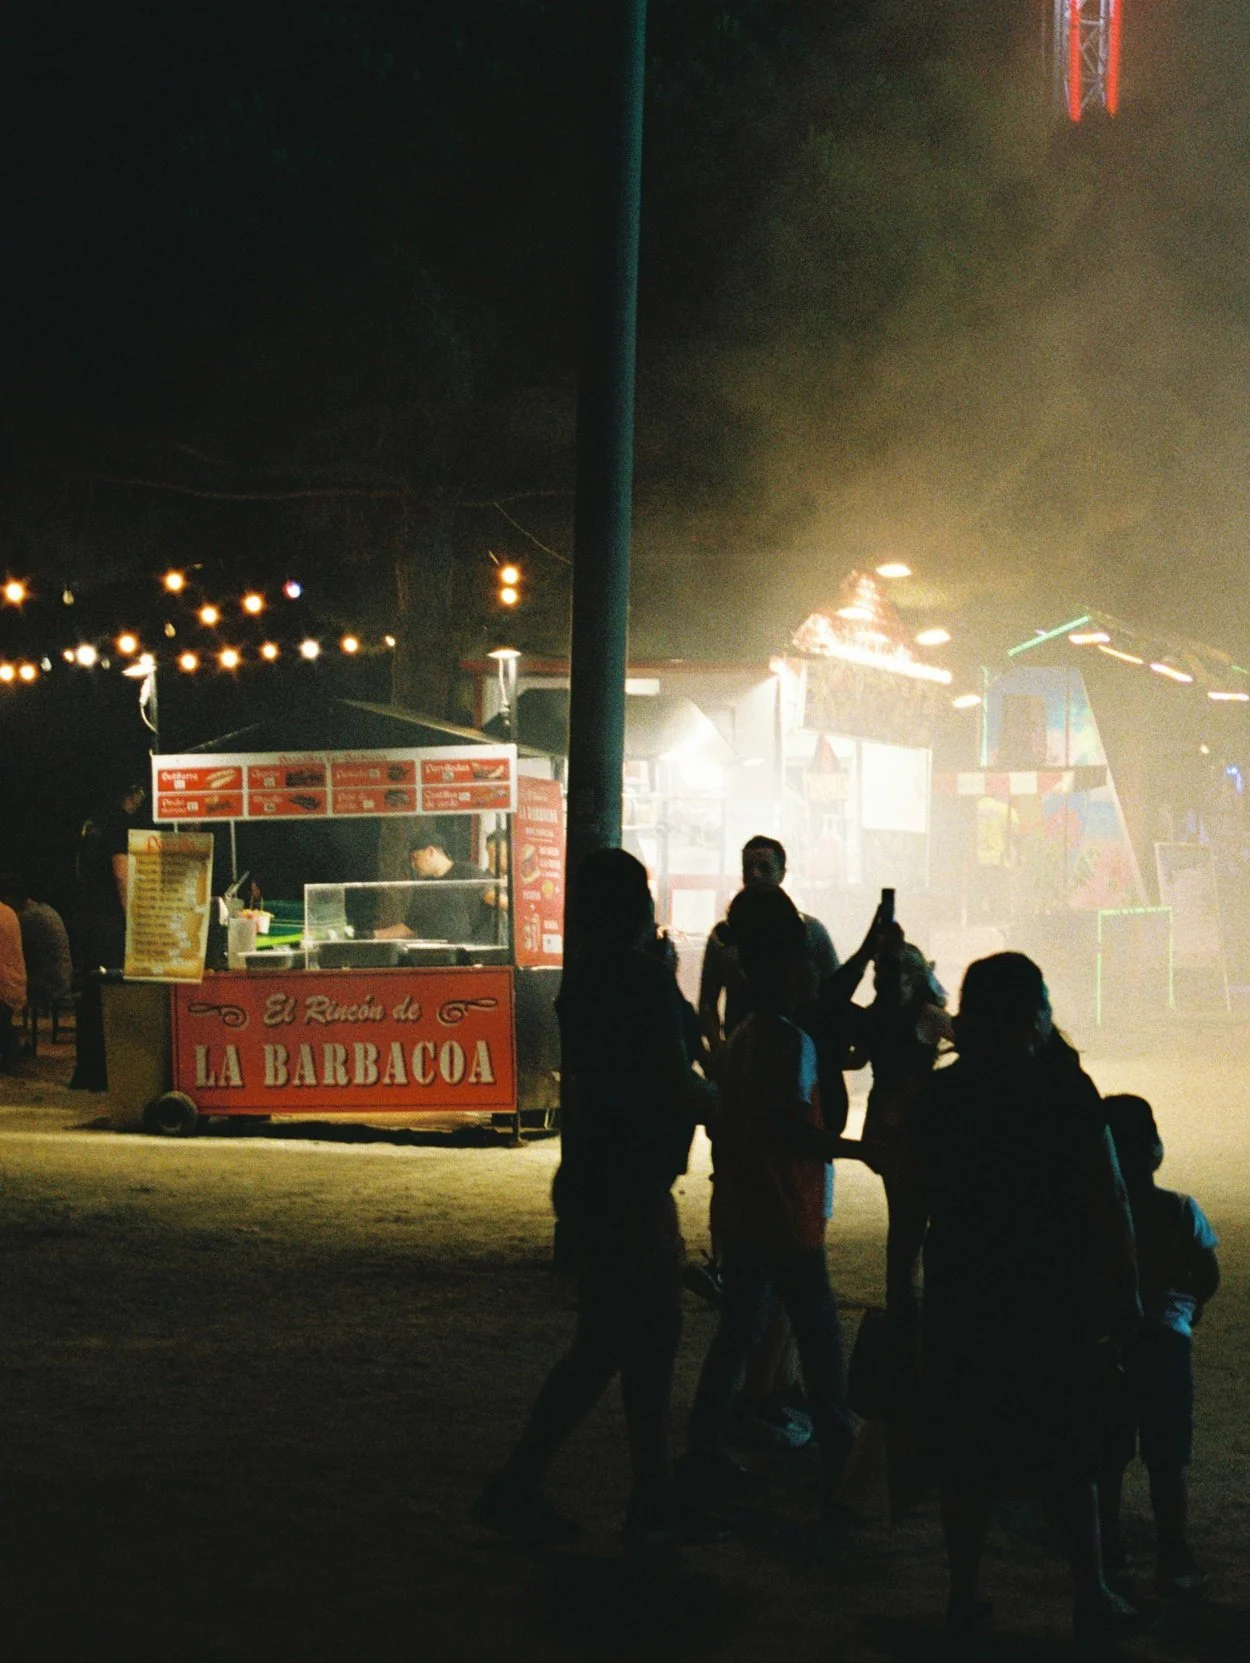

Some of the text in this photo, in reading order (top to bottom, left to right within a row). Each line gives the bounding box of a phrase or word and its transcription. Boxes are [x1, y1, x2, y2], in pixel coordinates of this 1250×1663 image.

[263, 992, 422, 1026] El Rincón de
[195, 1040, 496, 1088] LA BARBACOA
